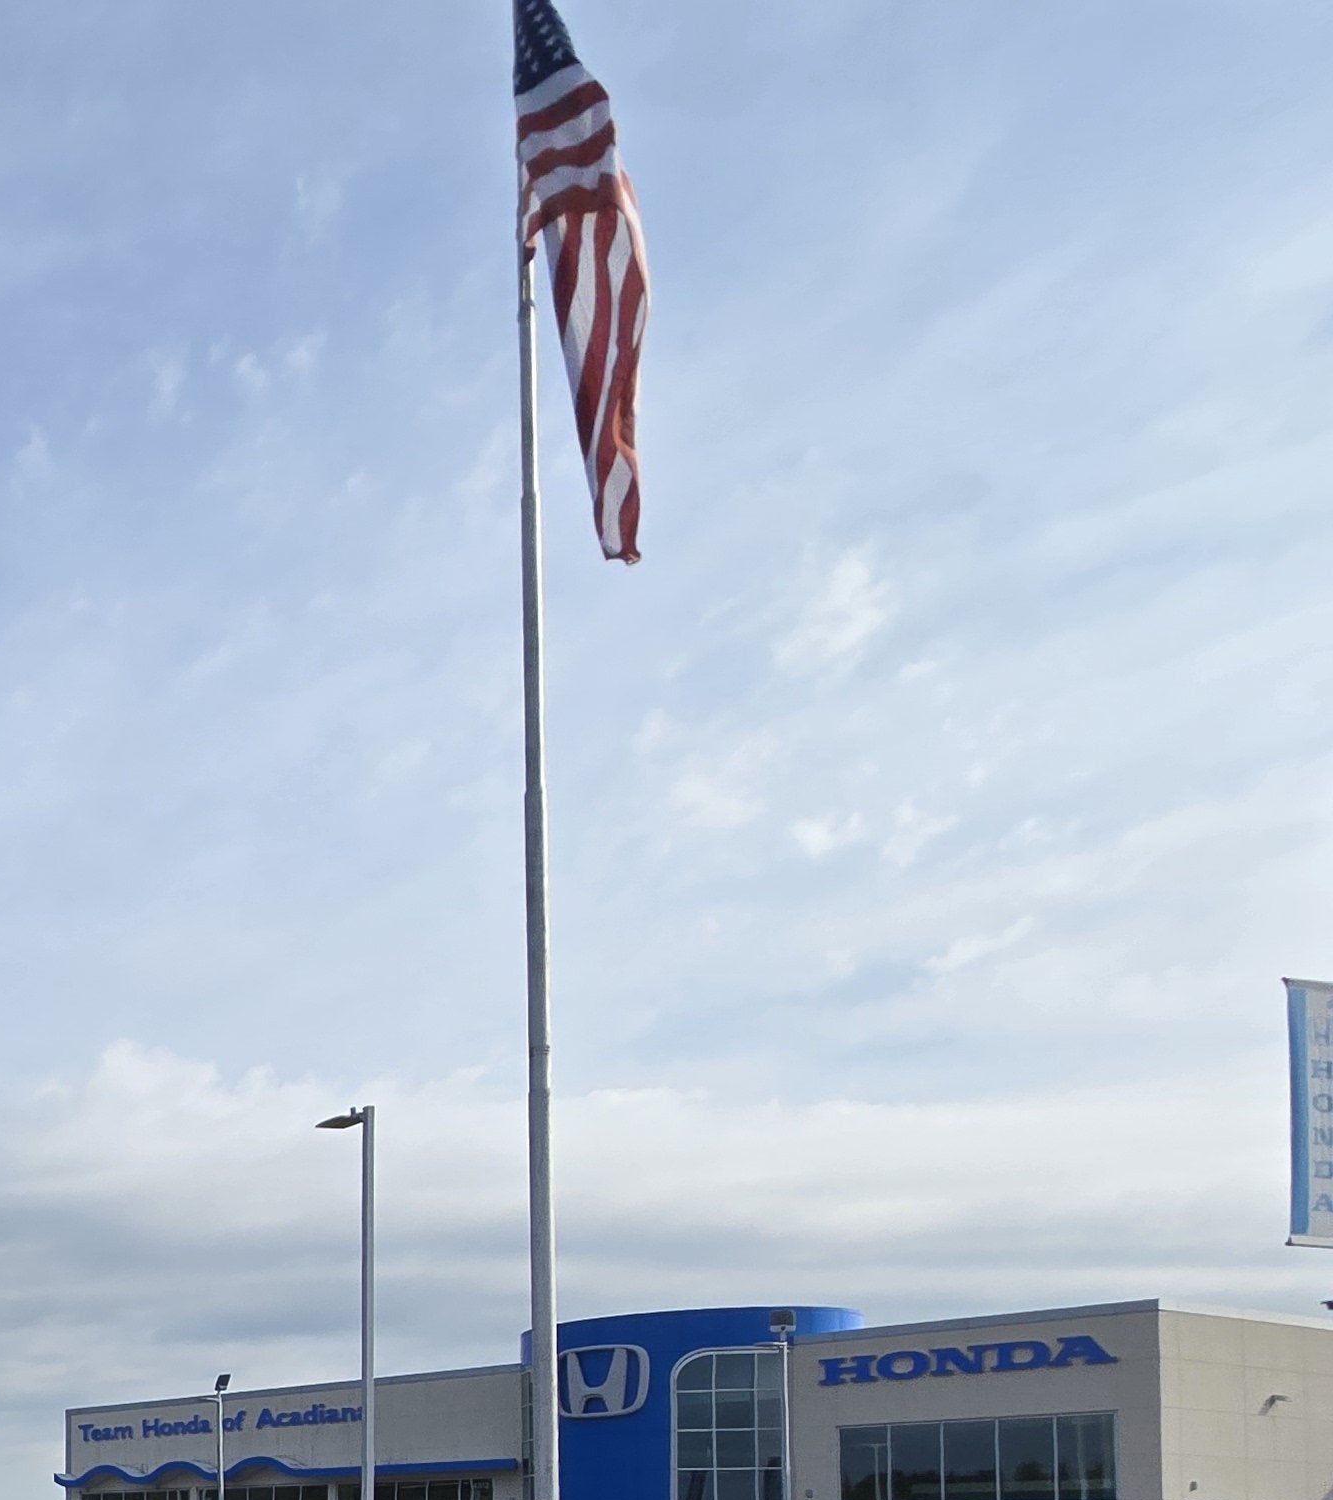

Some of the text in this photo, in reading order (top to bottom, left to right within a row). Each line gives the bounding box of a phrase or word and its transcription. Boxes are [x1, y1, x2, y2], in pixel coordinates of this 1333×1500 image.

[818, 1335, 1119, 1387] HONDA
[78, 1421, 134, 1442] Team
[141, 1413, 213, 1438] Honda
[221, 1410, 247, 1432] of
